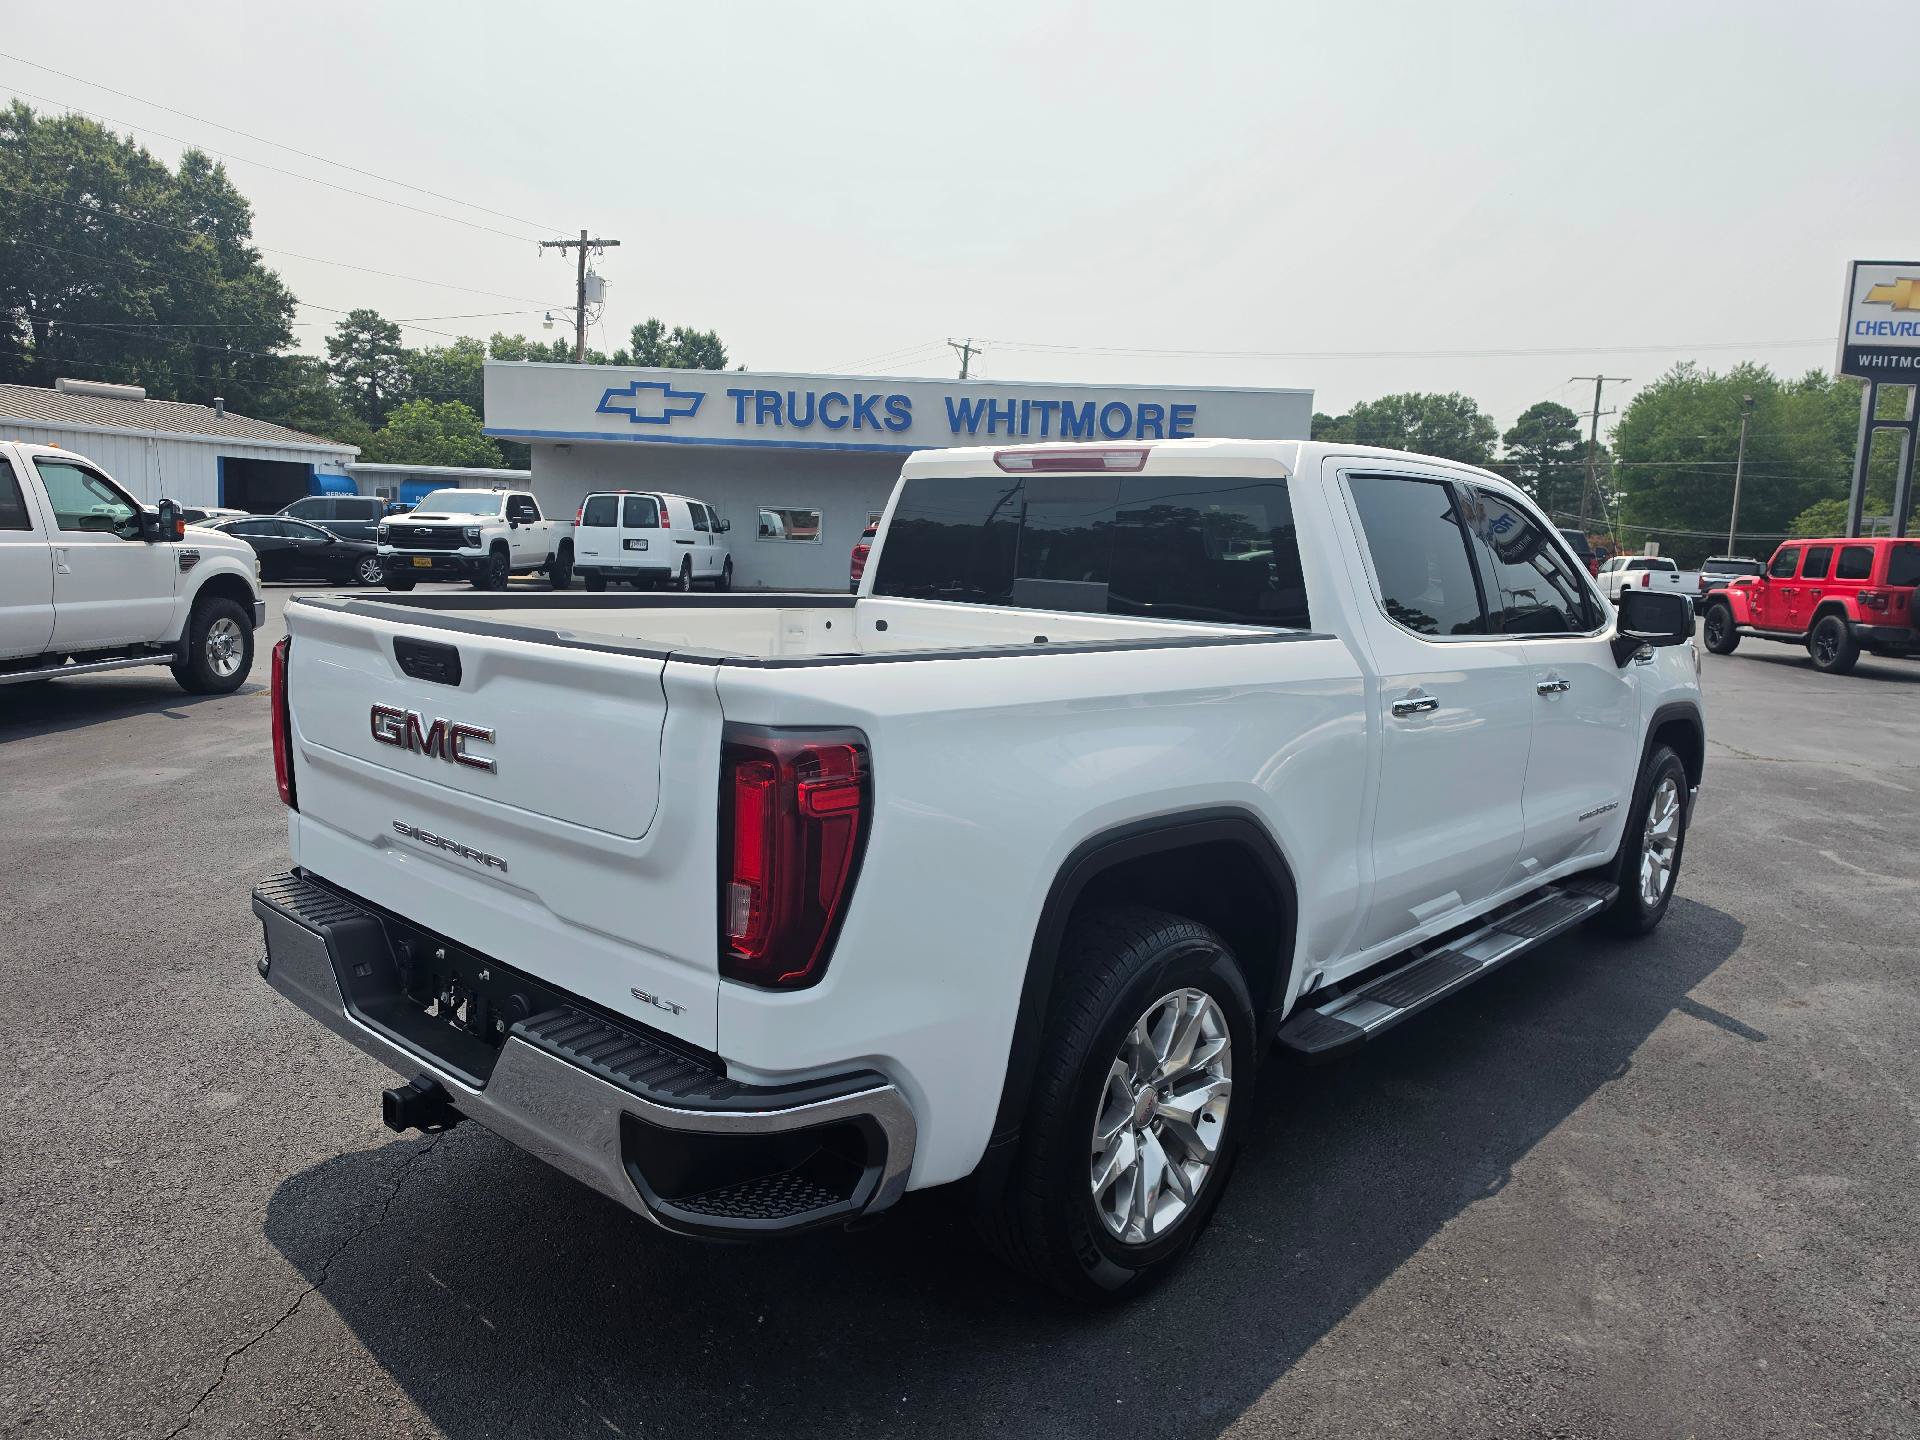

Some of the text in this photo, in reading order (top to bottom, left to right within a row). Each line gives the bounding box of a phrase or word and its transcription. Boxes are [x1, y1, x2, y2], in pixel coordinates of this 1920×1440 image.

[727, 388, 1198, 439] TRUCKS WHITMORE
[370, 701, 498, 775] GMC
[393, 819, 508, 873] SIERRA
[630, 987, 688, 1016] SLT
